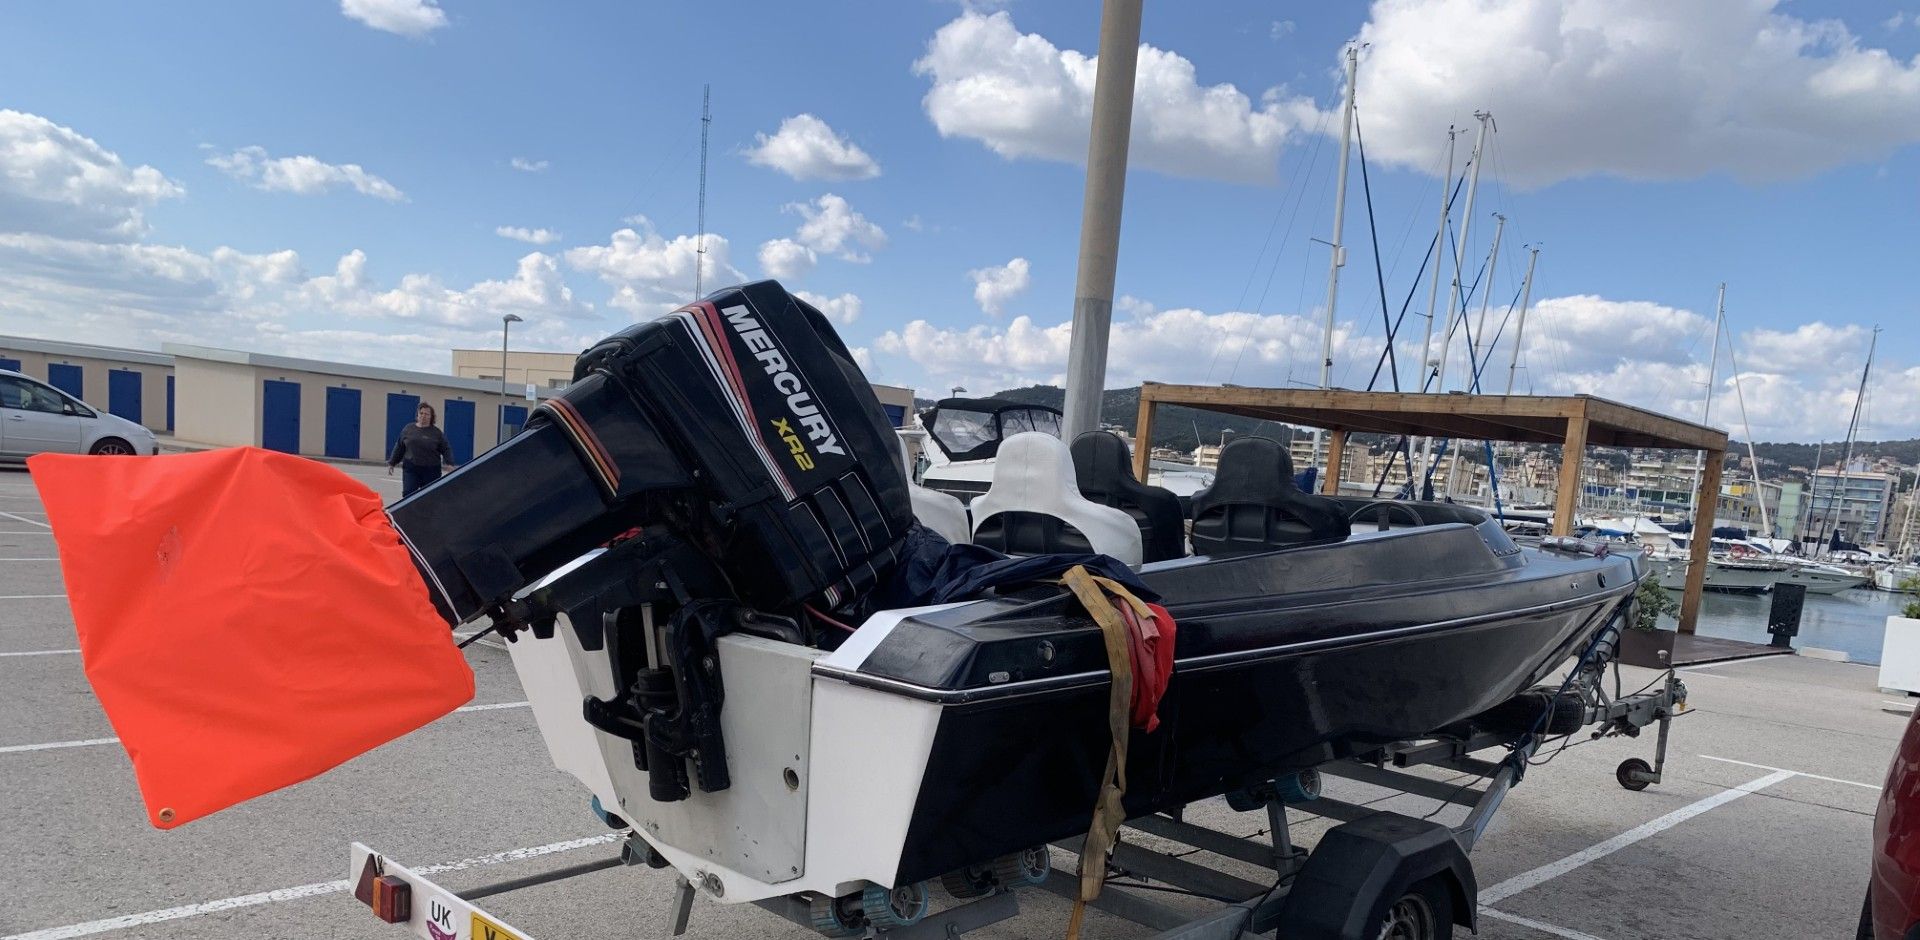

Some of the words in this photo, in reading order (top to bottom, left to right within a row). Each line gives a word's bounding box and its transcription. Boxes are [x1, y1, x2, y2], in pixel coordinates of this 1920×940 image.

[722, 305, 846, 456] MERCURY
[771, 417, 815, 471] XR2
[431, 900, 451, 929] UK
